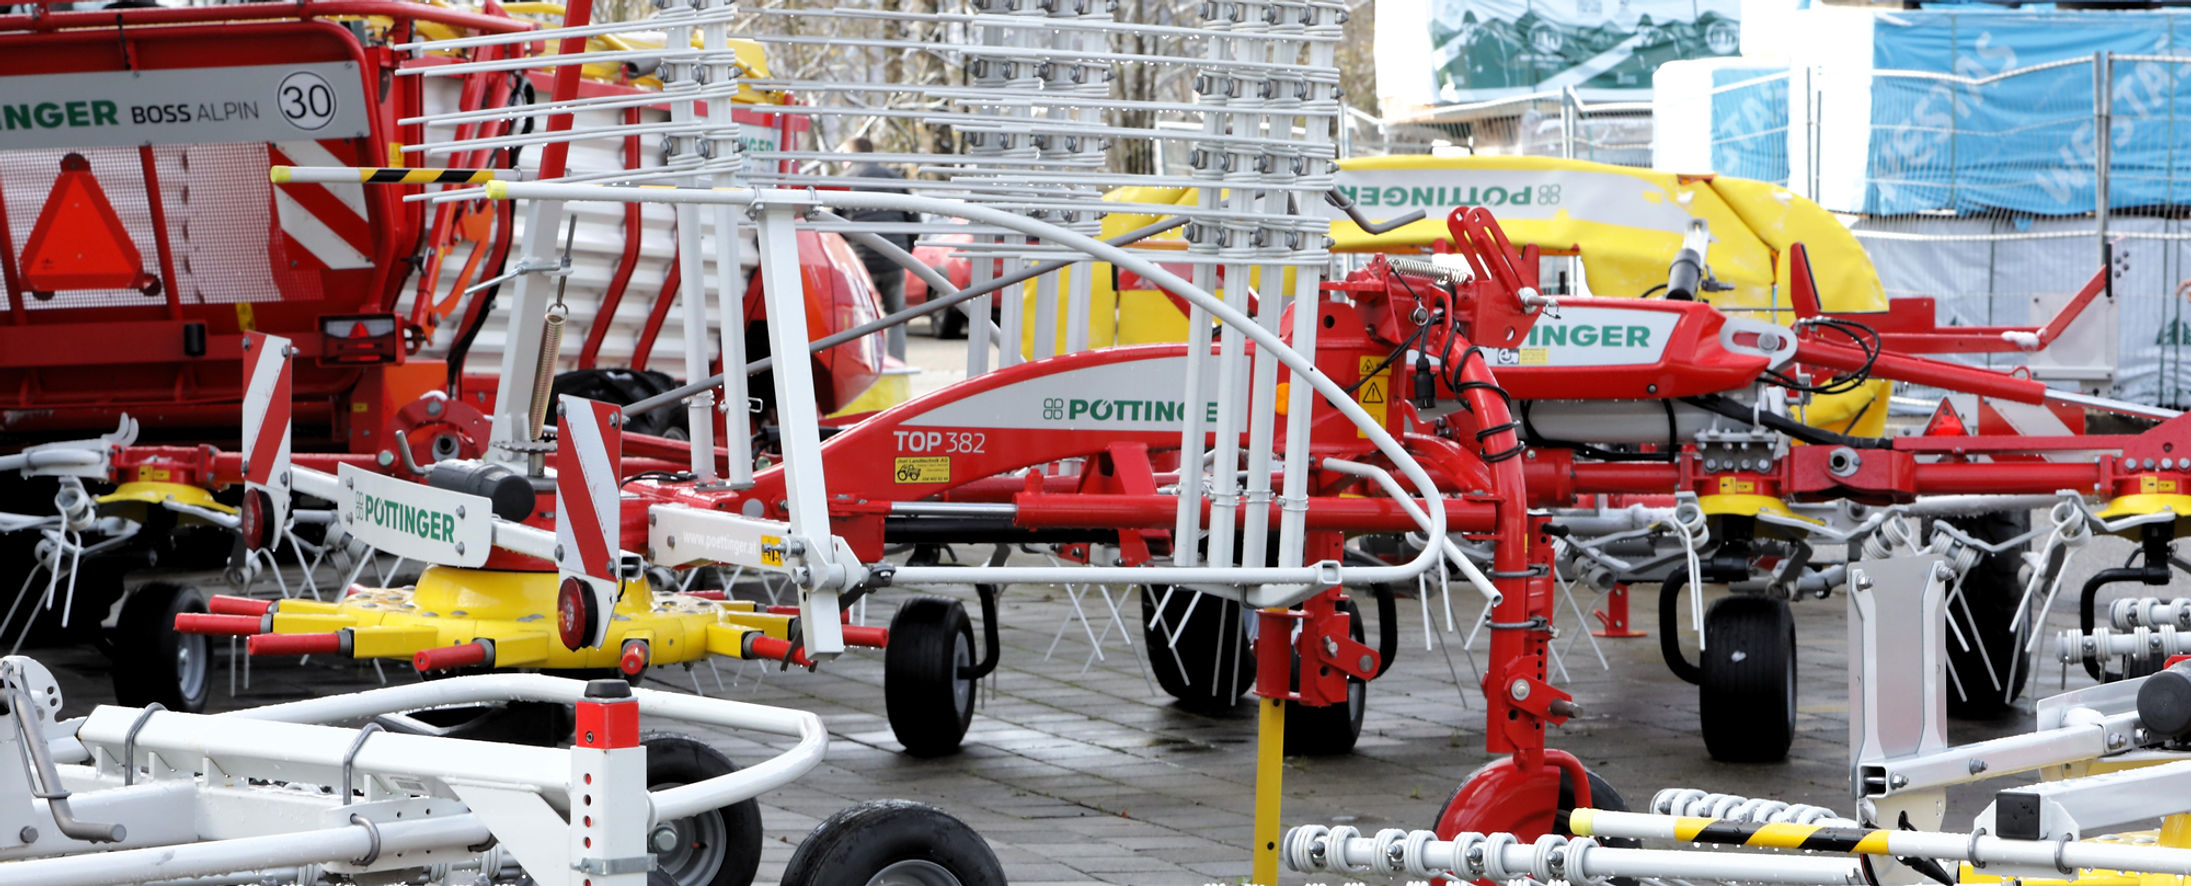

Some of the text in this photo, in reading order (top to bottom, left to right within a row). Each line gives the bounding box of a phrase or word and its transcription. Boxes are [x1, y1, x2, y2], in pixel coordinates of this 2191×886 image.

[282, 84, 332, 120] 30
[0, 100, 260, 131] NGER BOSS ALPIN
[1528, 324, 1650, 348] INGER
[1068, 398, 1218, 423] PÖTTINE
[893, 430, 985, 454] TOP 382
[683, 529, 758, 556] www.poettinger.at
